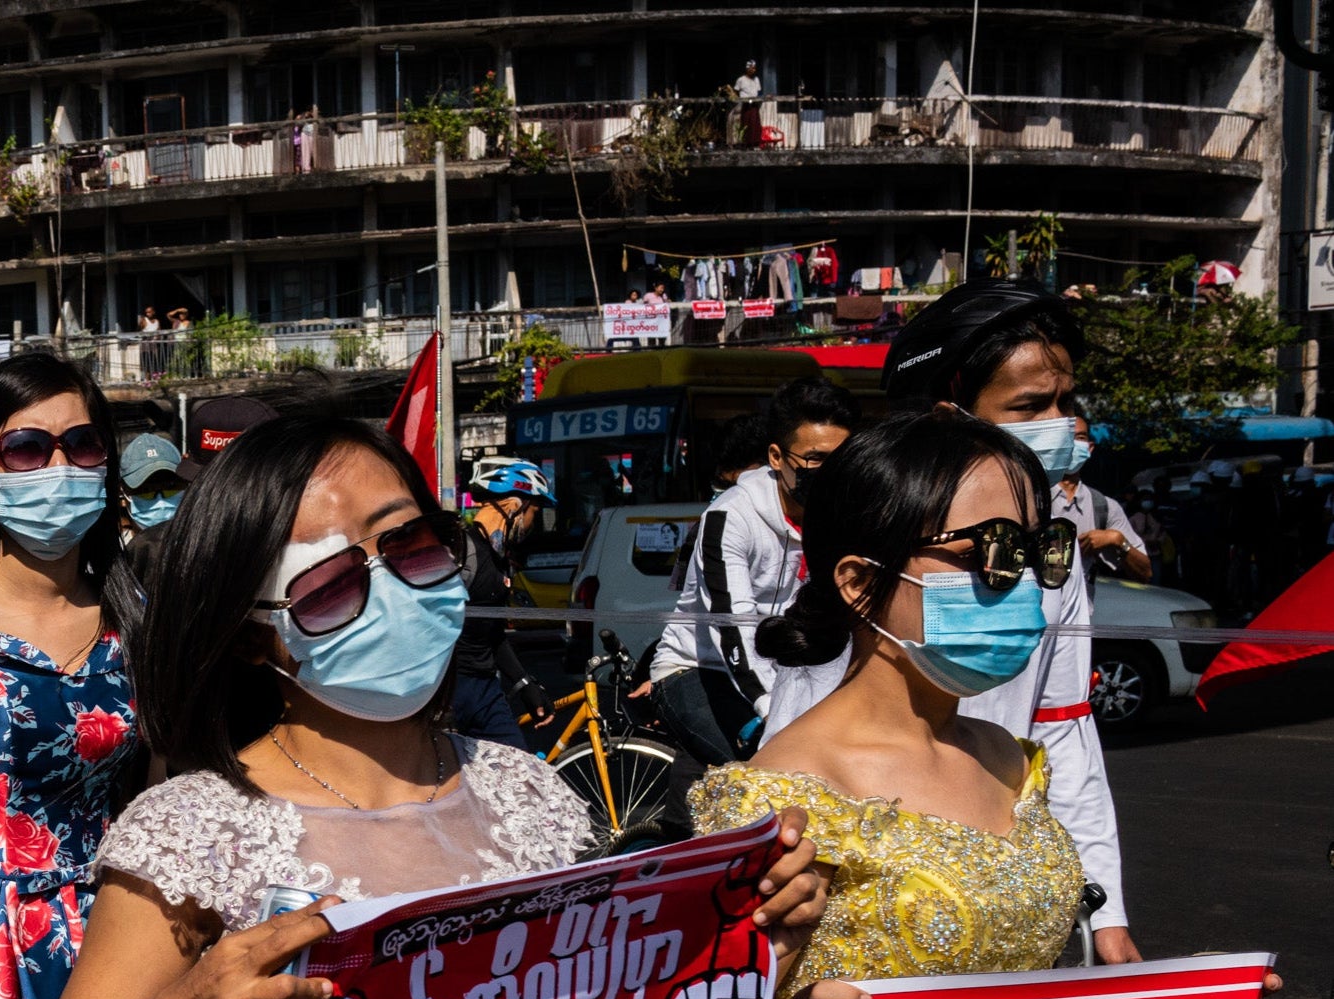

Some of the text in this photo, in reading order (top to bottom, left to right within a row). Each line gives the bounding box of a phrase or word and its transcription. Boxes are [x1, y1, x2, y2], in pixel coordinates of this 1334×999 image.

[897, 346, 943, 372] MERIDA
[559, 408, 619, 437] YBS
[632, 405, 662, 432] 65
